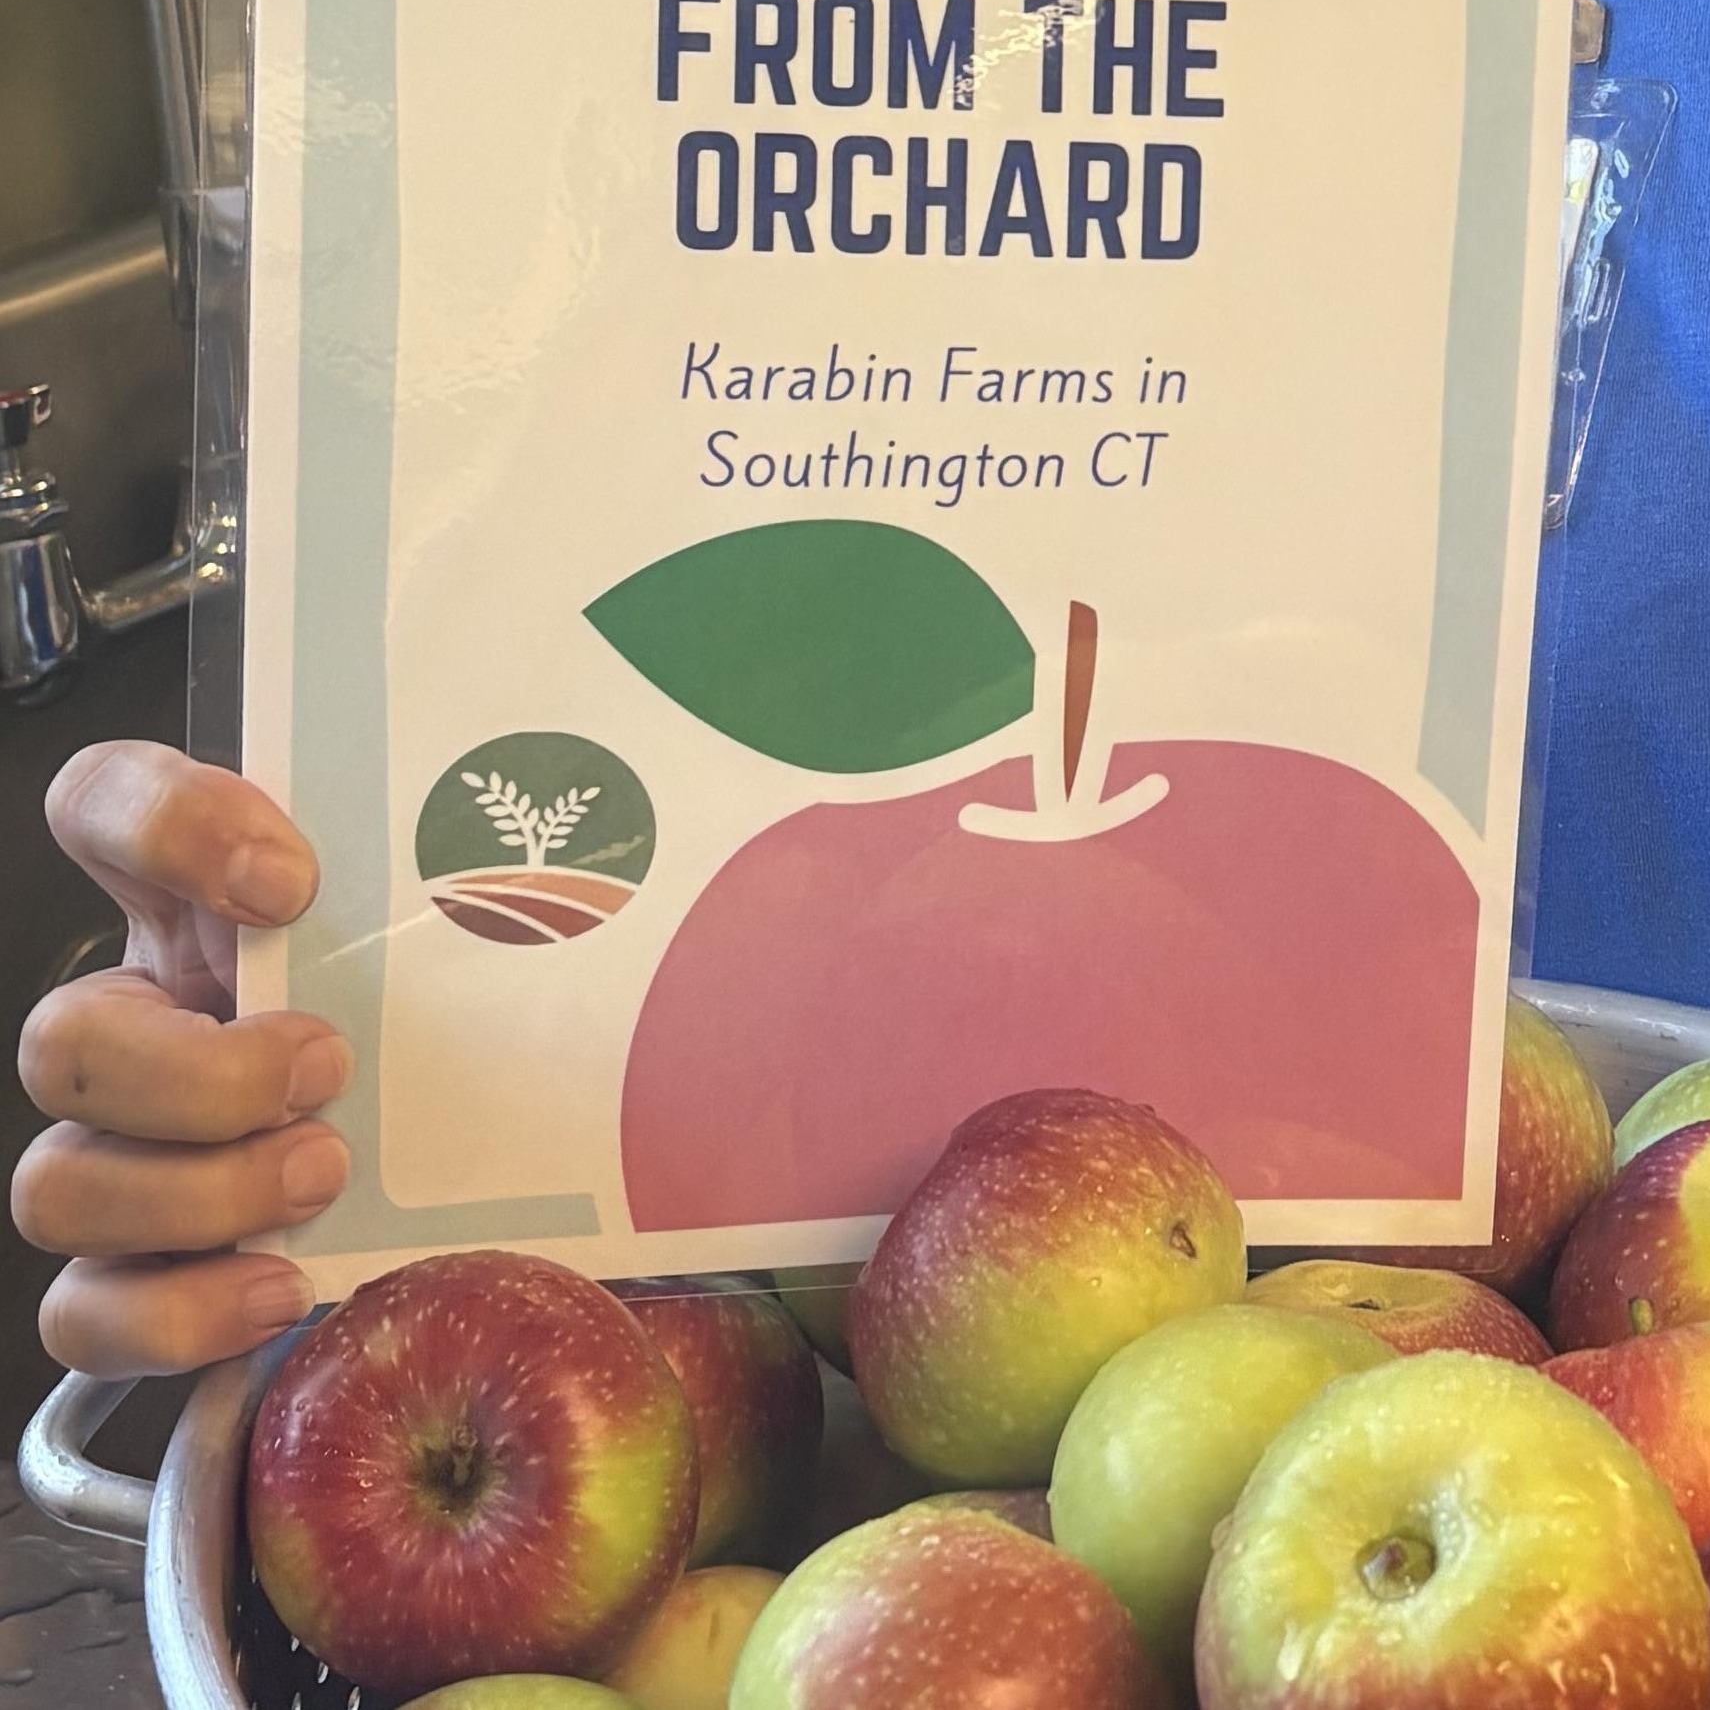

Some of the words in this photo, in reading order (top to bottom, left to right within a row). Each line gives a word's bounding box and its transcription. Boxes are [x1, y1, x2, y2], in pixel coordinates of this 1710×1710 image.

[675, 129, 1203, 261] ORCHARD
[681, 341, 912, 402] Karabin
[939, 346, 1114, 404] Farms
[1139, 356, 1188, 404] in
[700, 429, 1065, 508] Southington
[1091, 431, 1170, 488] CT
